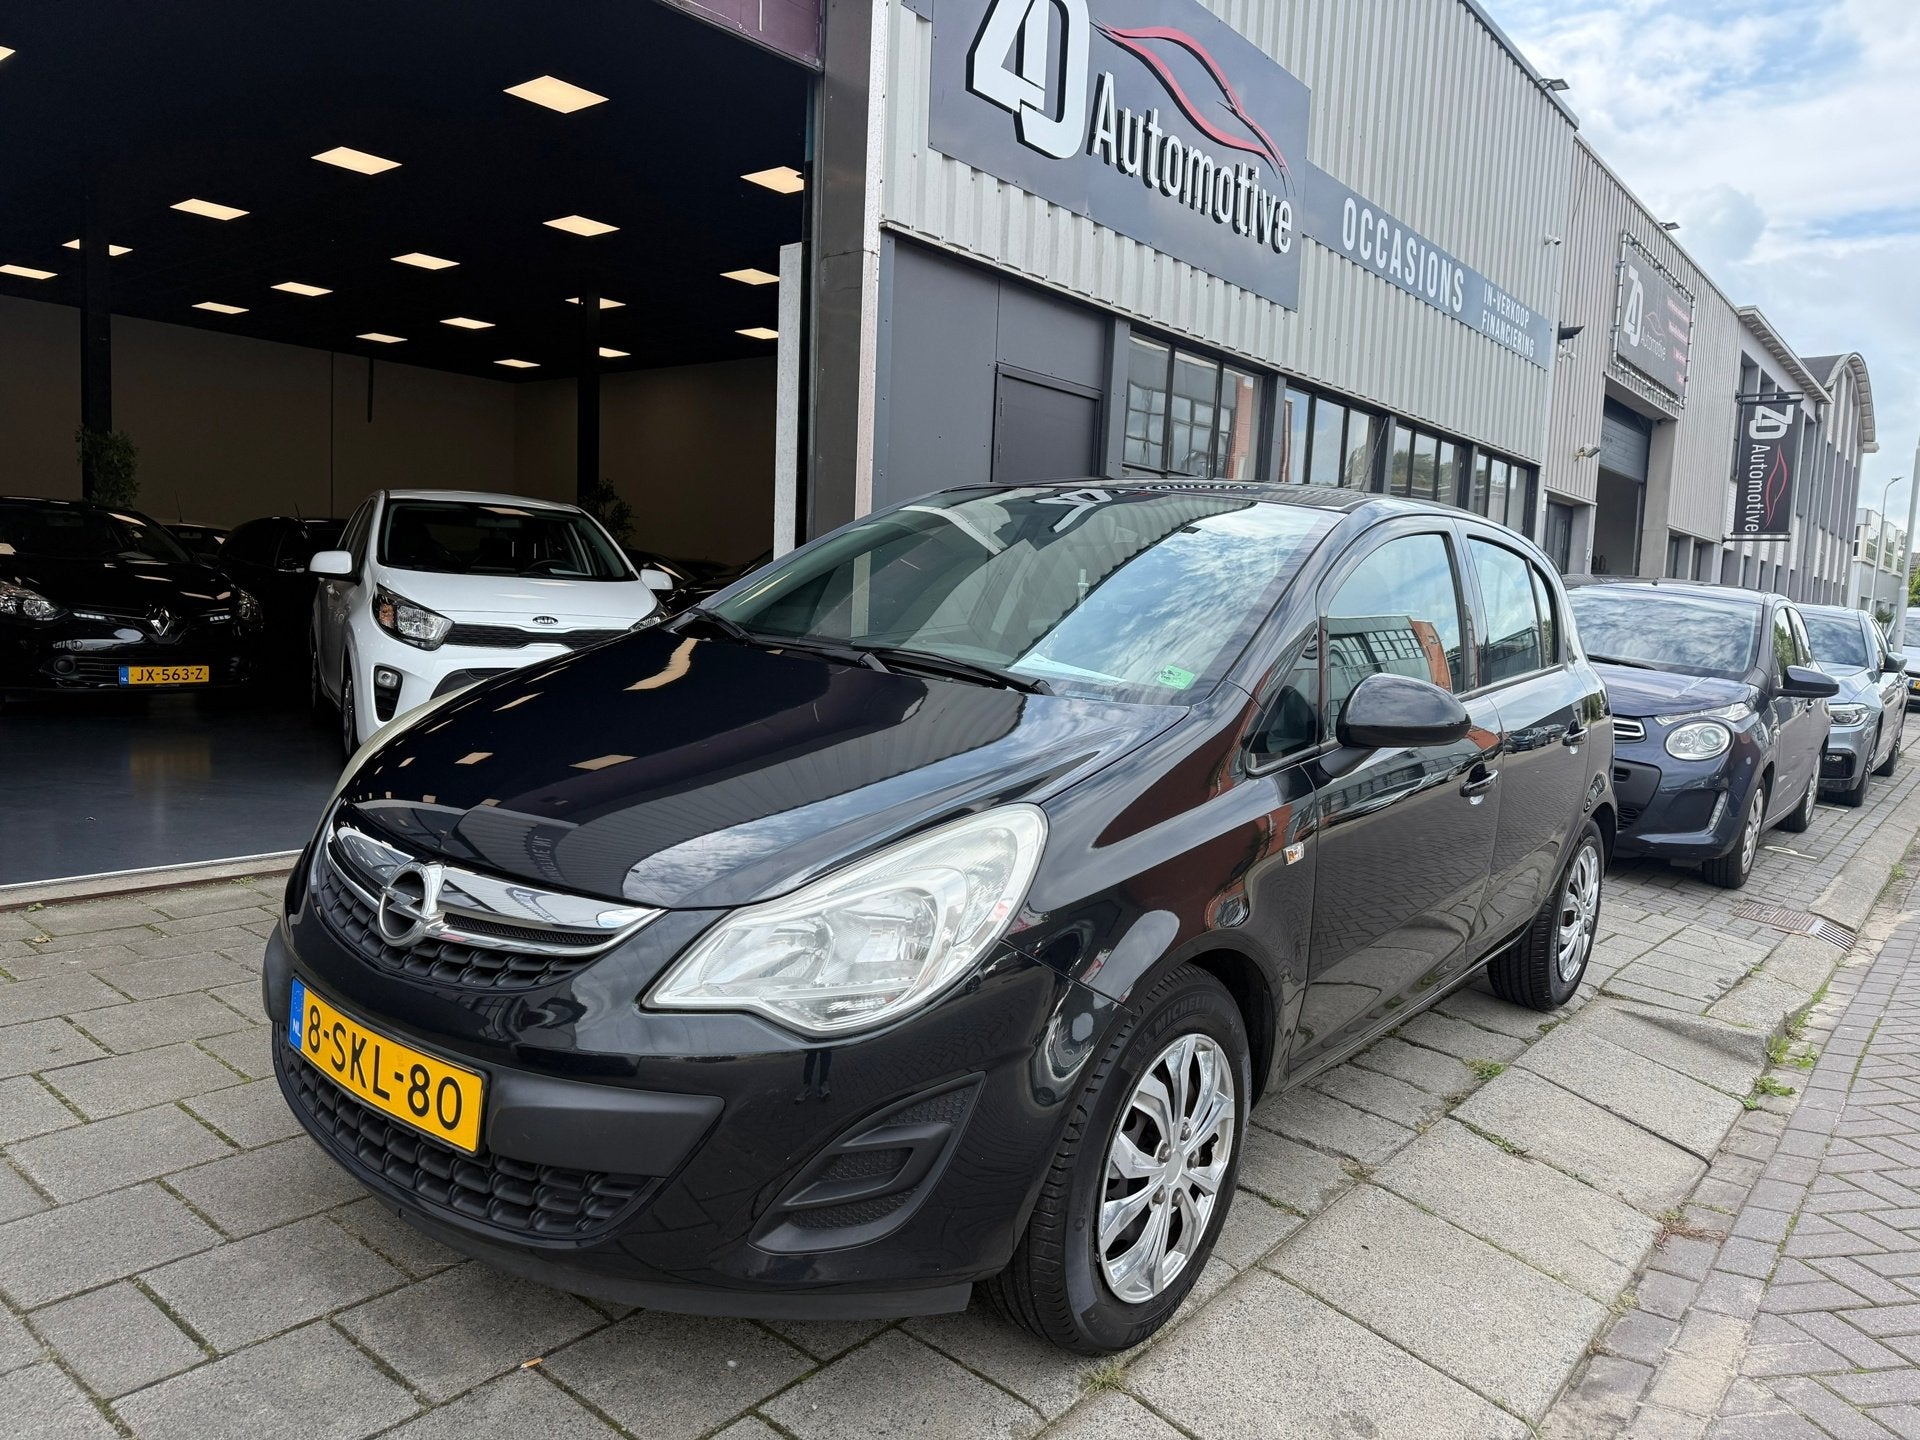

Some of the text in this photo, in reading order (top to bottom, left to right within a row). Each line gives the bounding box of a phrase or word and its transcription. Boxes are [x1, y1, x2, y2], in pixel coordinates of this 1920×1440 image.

[1089, 70, 1293, 254] Automotive
[1342, 197, 1465, 313] OCCASIONS
[1481, 310, 1535, 358] FINANCIERING
[1483, 282, 1530, 330] IN-VERKOOP
[1744, 443, 1772, 532] Automotive
[136, 667, 204, 682] JX-563-Z
[308, 1004, 463, 1131] 8-SKL-80
